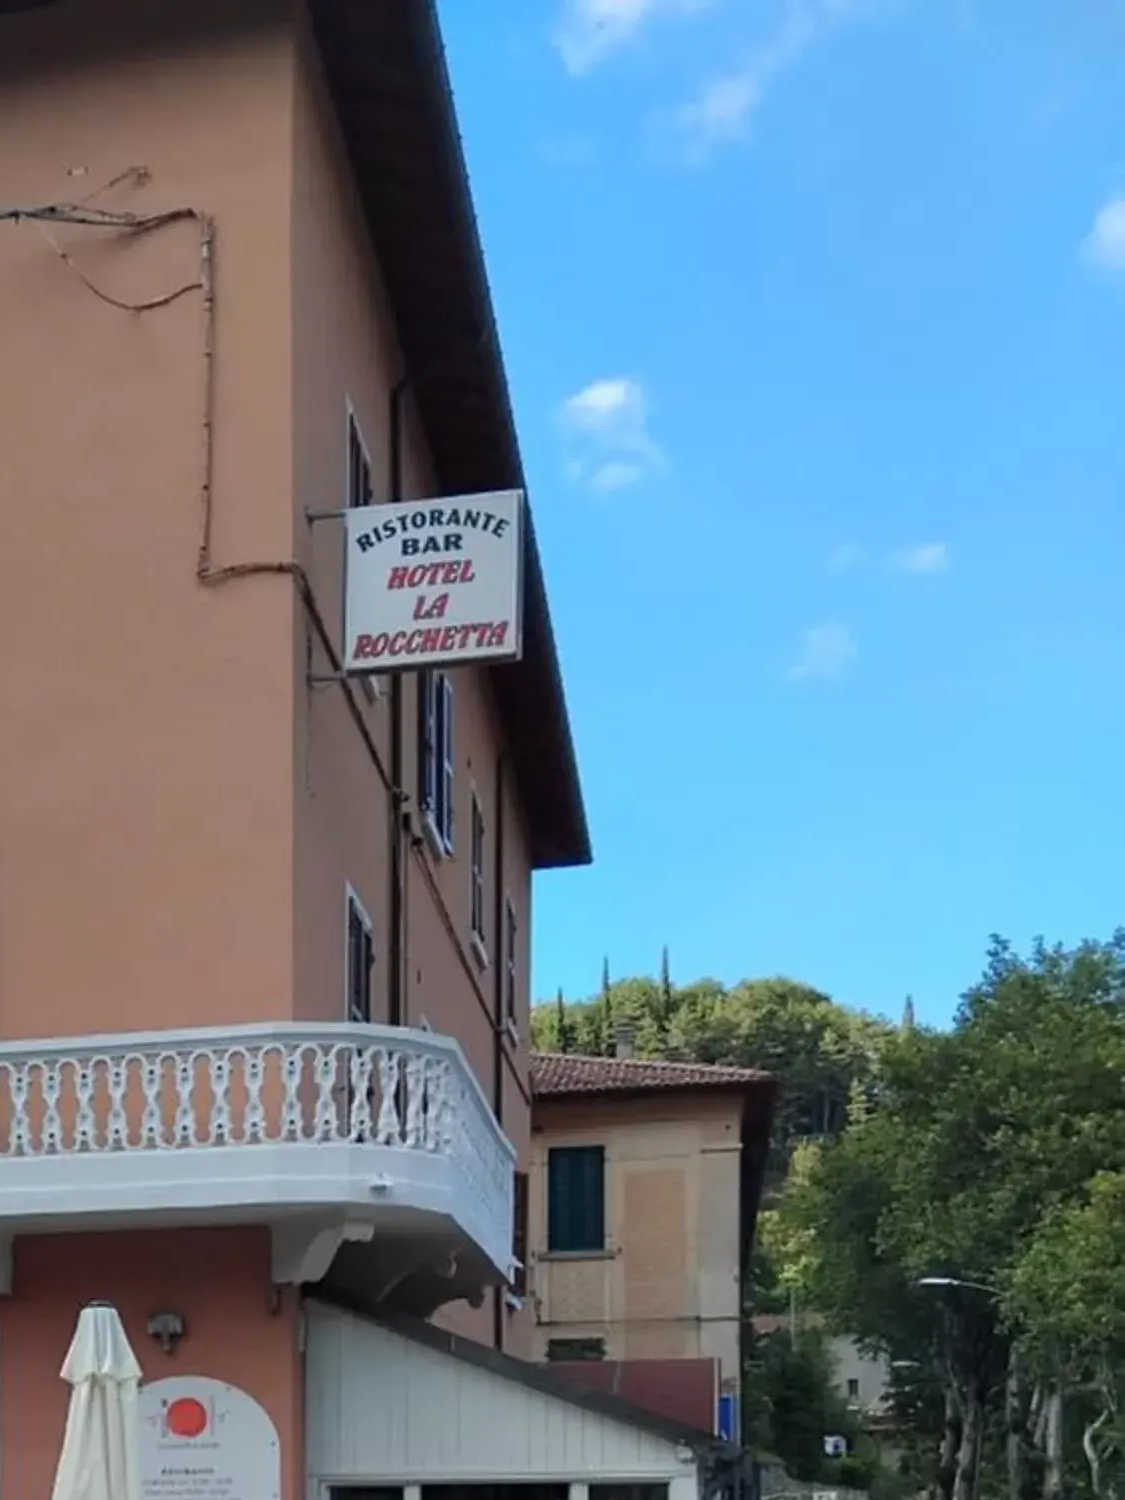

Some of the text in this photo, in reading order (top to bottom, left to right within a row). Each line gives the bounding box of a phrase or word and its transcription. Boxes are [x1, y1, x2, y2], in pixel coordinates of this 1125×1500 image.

[356, 509, 510, 553] RISTORANTE
[401, 533, 463, 556] BAR
[387, 559, 475, 590] HOTEL
[413, 592, 450, 621] LA
[352, 621, 508, 661] ROCCHETTA
